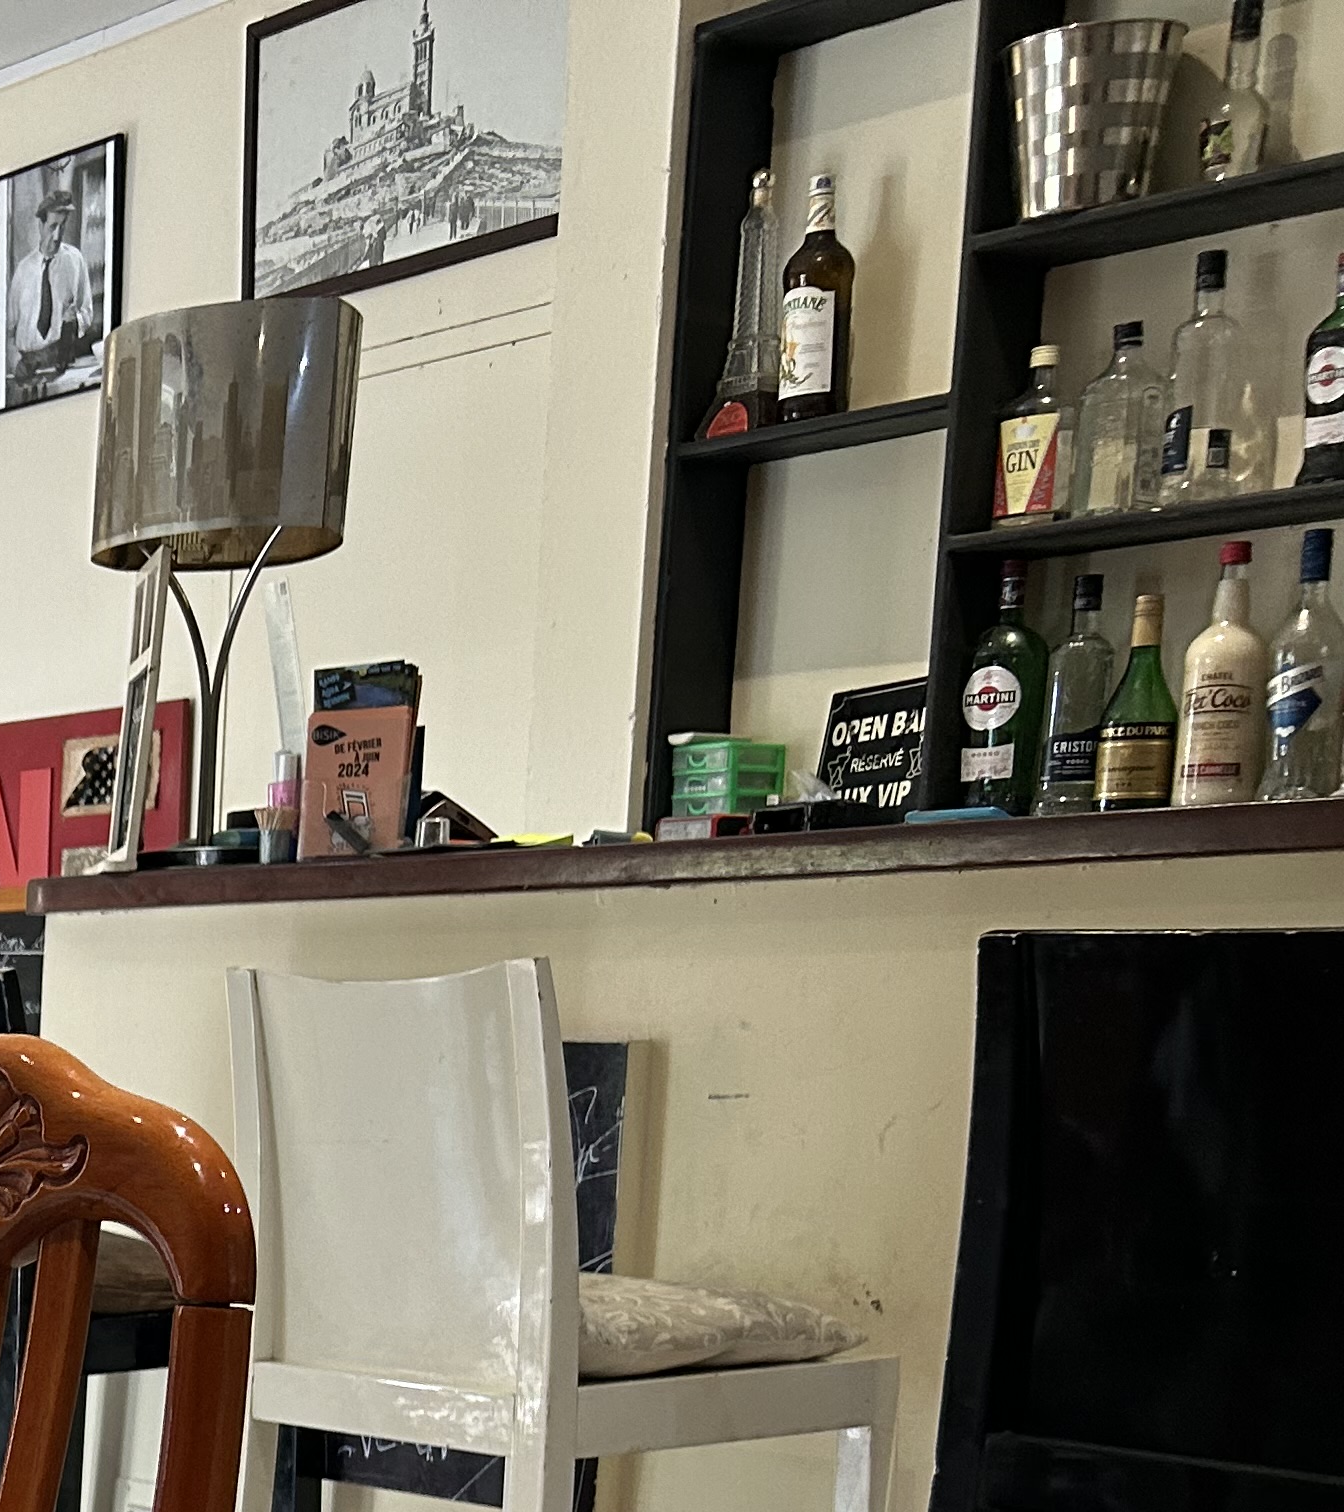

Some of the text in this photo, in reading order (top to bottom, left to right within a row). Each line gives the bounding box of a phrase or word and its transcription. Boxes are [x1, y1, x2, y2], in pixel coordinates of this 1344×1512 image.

[1006, 449, 1039, 474] GIN
[966, 691, 1015, 706] MARTINI
[832, 713, 889, 747] OPEN
[1127, 725, 1143, 737] DU
[335, 738, 382, 754] DE FÉVRIER
[362, 752, 380, 763] JUIN
[338, 762, 369, 778] 2024
[878, 780, 912, 809] VIP
